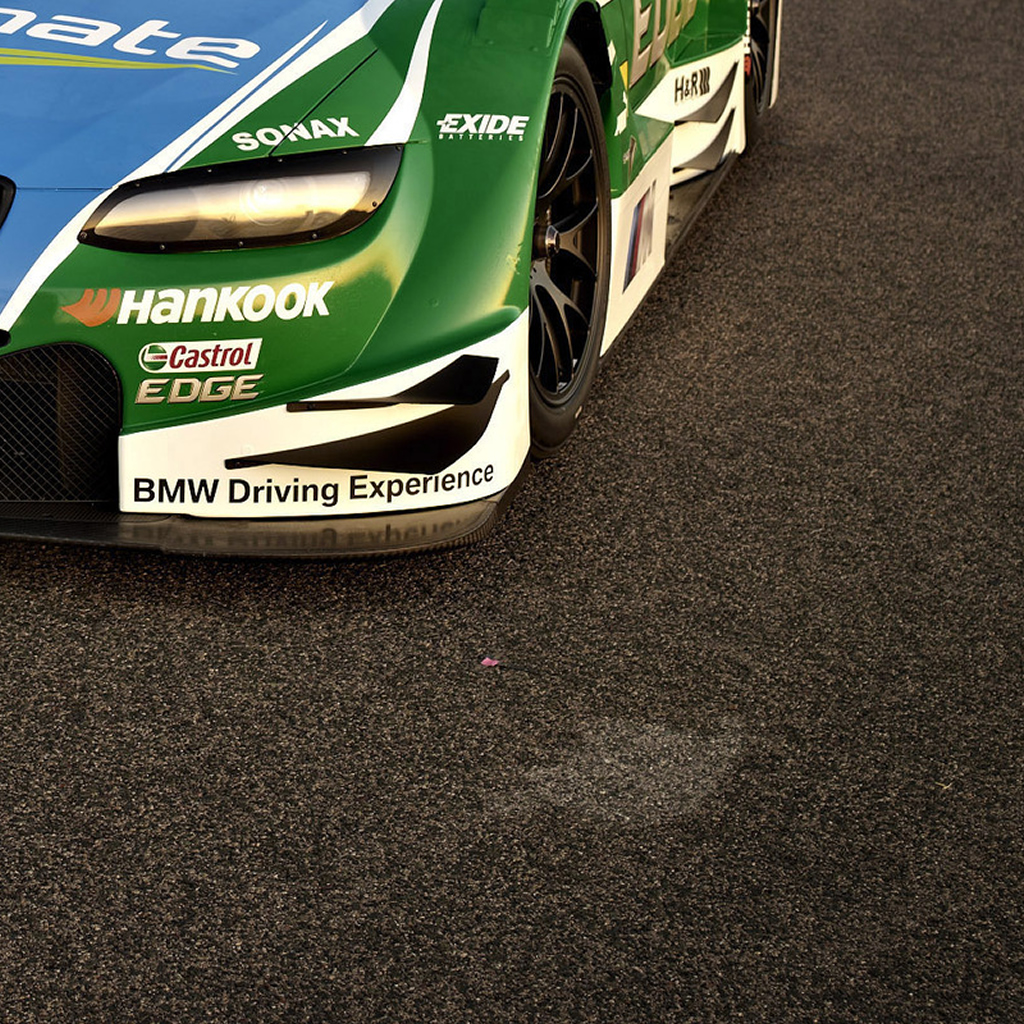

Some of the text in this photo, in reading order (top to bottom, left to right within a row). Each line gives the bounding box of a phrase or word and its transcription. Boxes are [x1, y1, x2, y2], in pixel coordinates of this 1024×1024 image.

[674, 73, 699, 104] H&R
[231, 117, 360, 152] SONAX
[436, 113, 530, 136] EXIDE
[438, 133, 524, 141] BATTERIES
[169, 342, 253, 369] Castrol
[134, 374, 264, 404] EDGE
[133, 462, 494, 507] BMW Driving Experience
